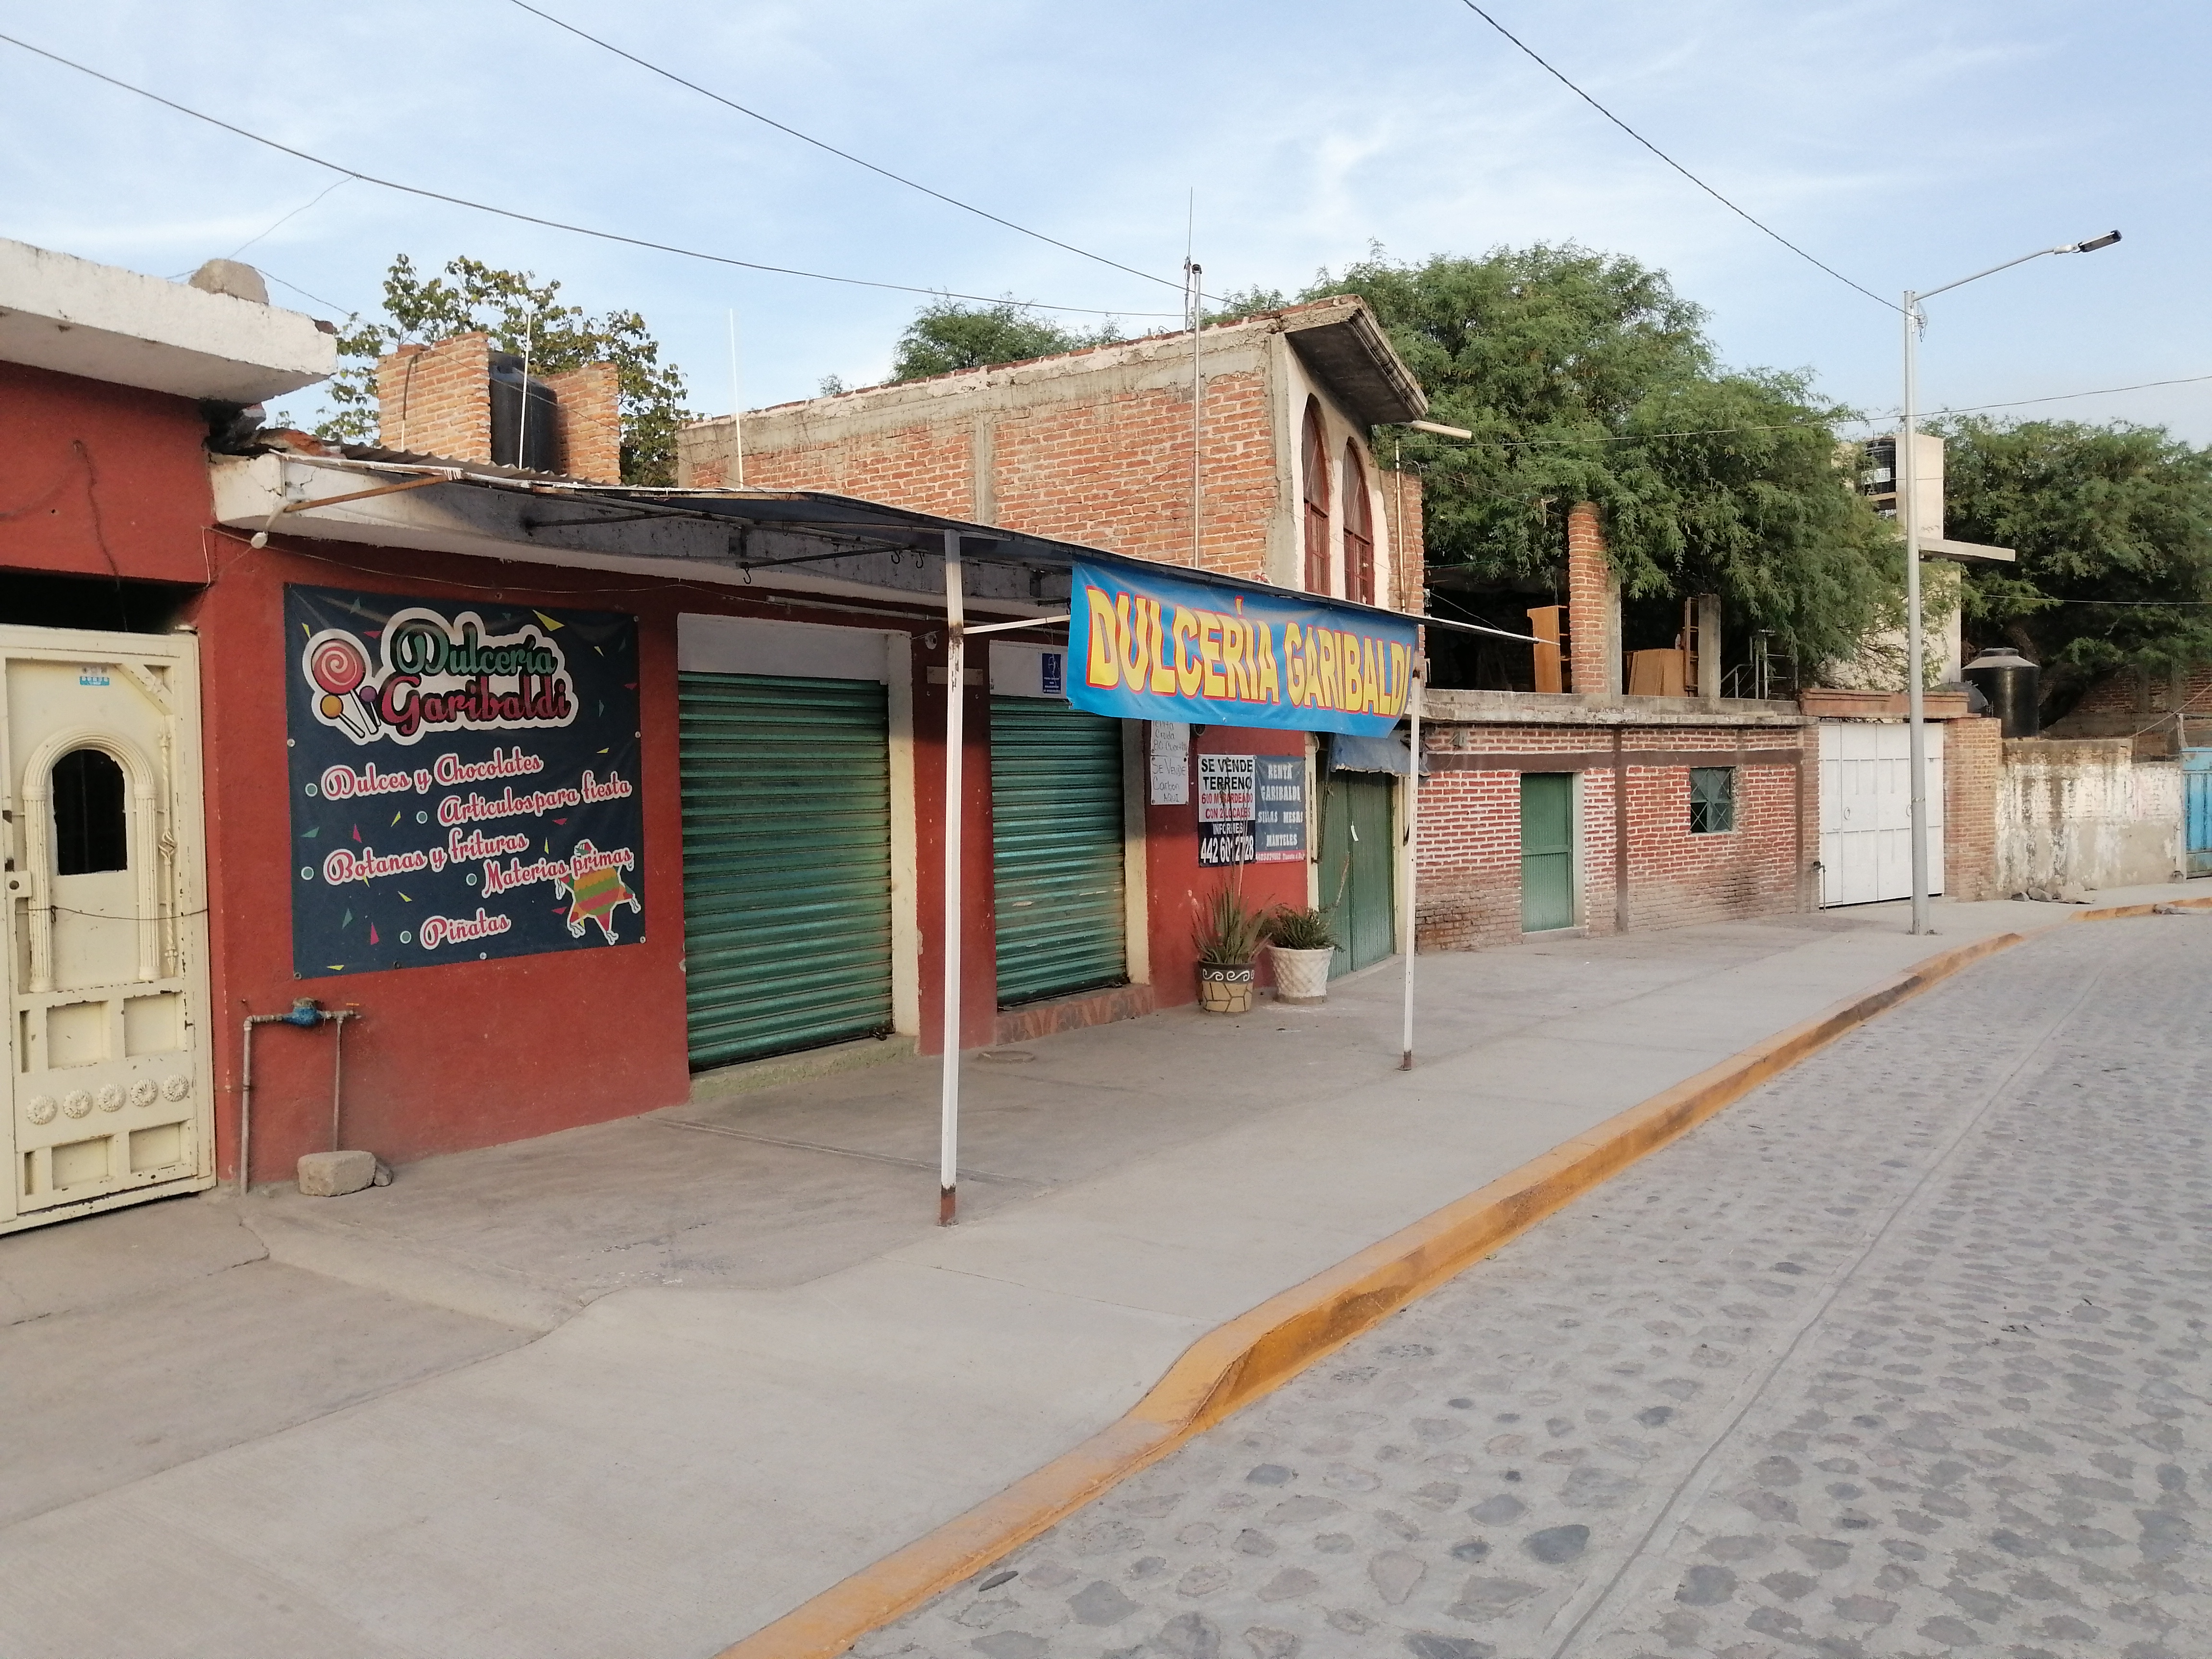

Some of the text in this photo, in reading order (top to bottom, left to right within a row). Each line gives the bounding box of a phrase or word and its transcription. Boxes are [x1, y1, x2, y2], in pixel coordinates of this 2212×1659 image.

[393, 620, 557, 675] Dulcería
[1086, 584, 1411, 719] DULCERÍA GARIBALDI
[381, 673, 571, 735] Garibaldi
[323, 747, 543, 798] Dulces y Chocolates
[1202, 758, 1253, 772] SE VENDE
[1268, 763, 1293, 780] RENTA
[582, 770, 632, 801] fiesta
[1153, 776, 1179, 791] Carbon
[1203, 776, 1252, 791] TERRENO
[1261, 785, 1301, 802] GARIBALDI
[1202, 793, 1212, 804] 600
[1205, 807, 1250, 819] CON 2 LOCALES
[1213, 822, 1243, 835] INFORMES
[1201, 837, 1218, 864] 442
[1266, 834, 1298, 847] MANTELES
[325, 829, 529, 883] Botanas y frituras
[482, 848, 634, 897] Materias primas
[421, 908, 511, 948] Piñatas
